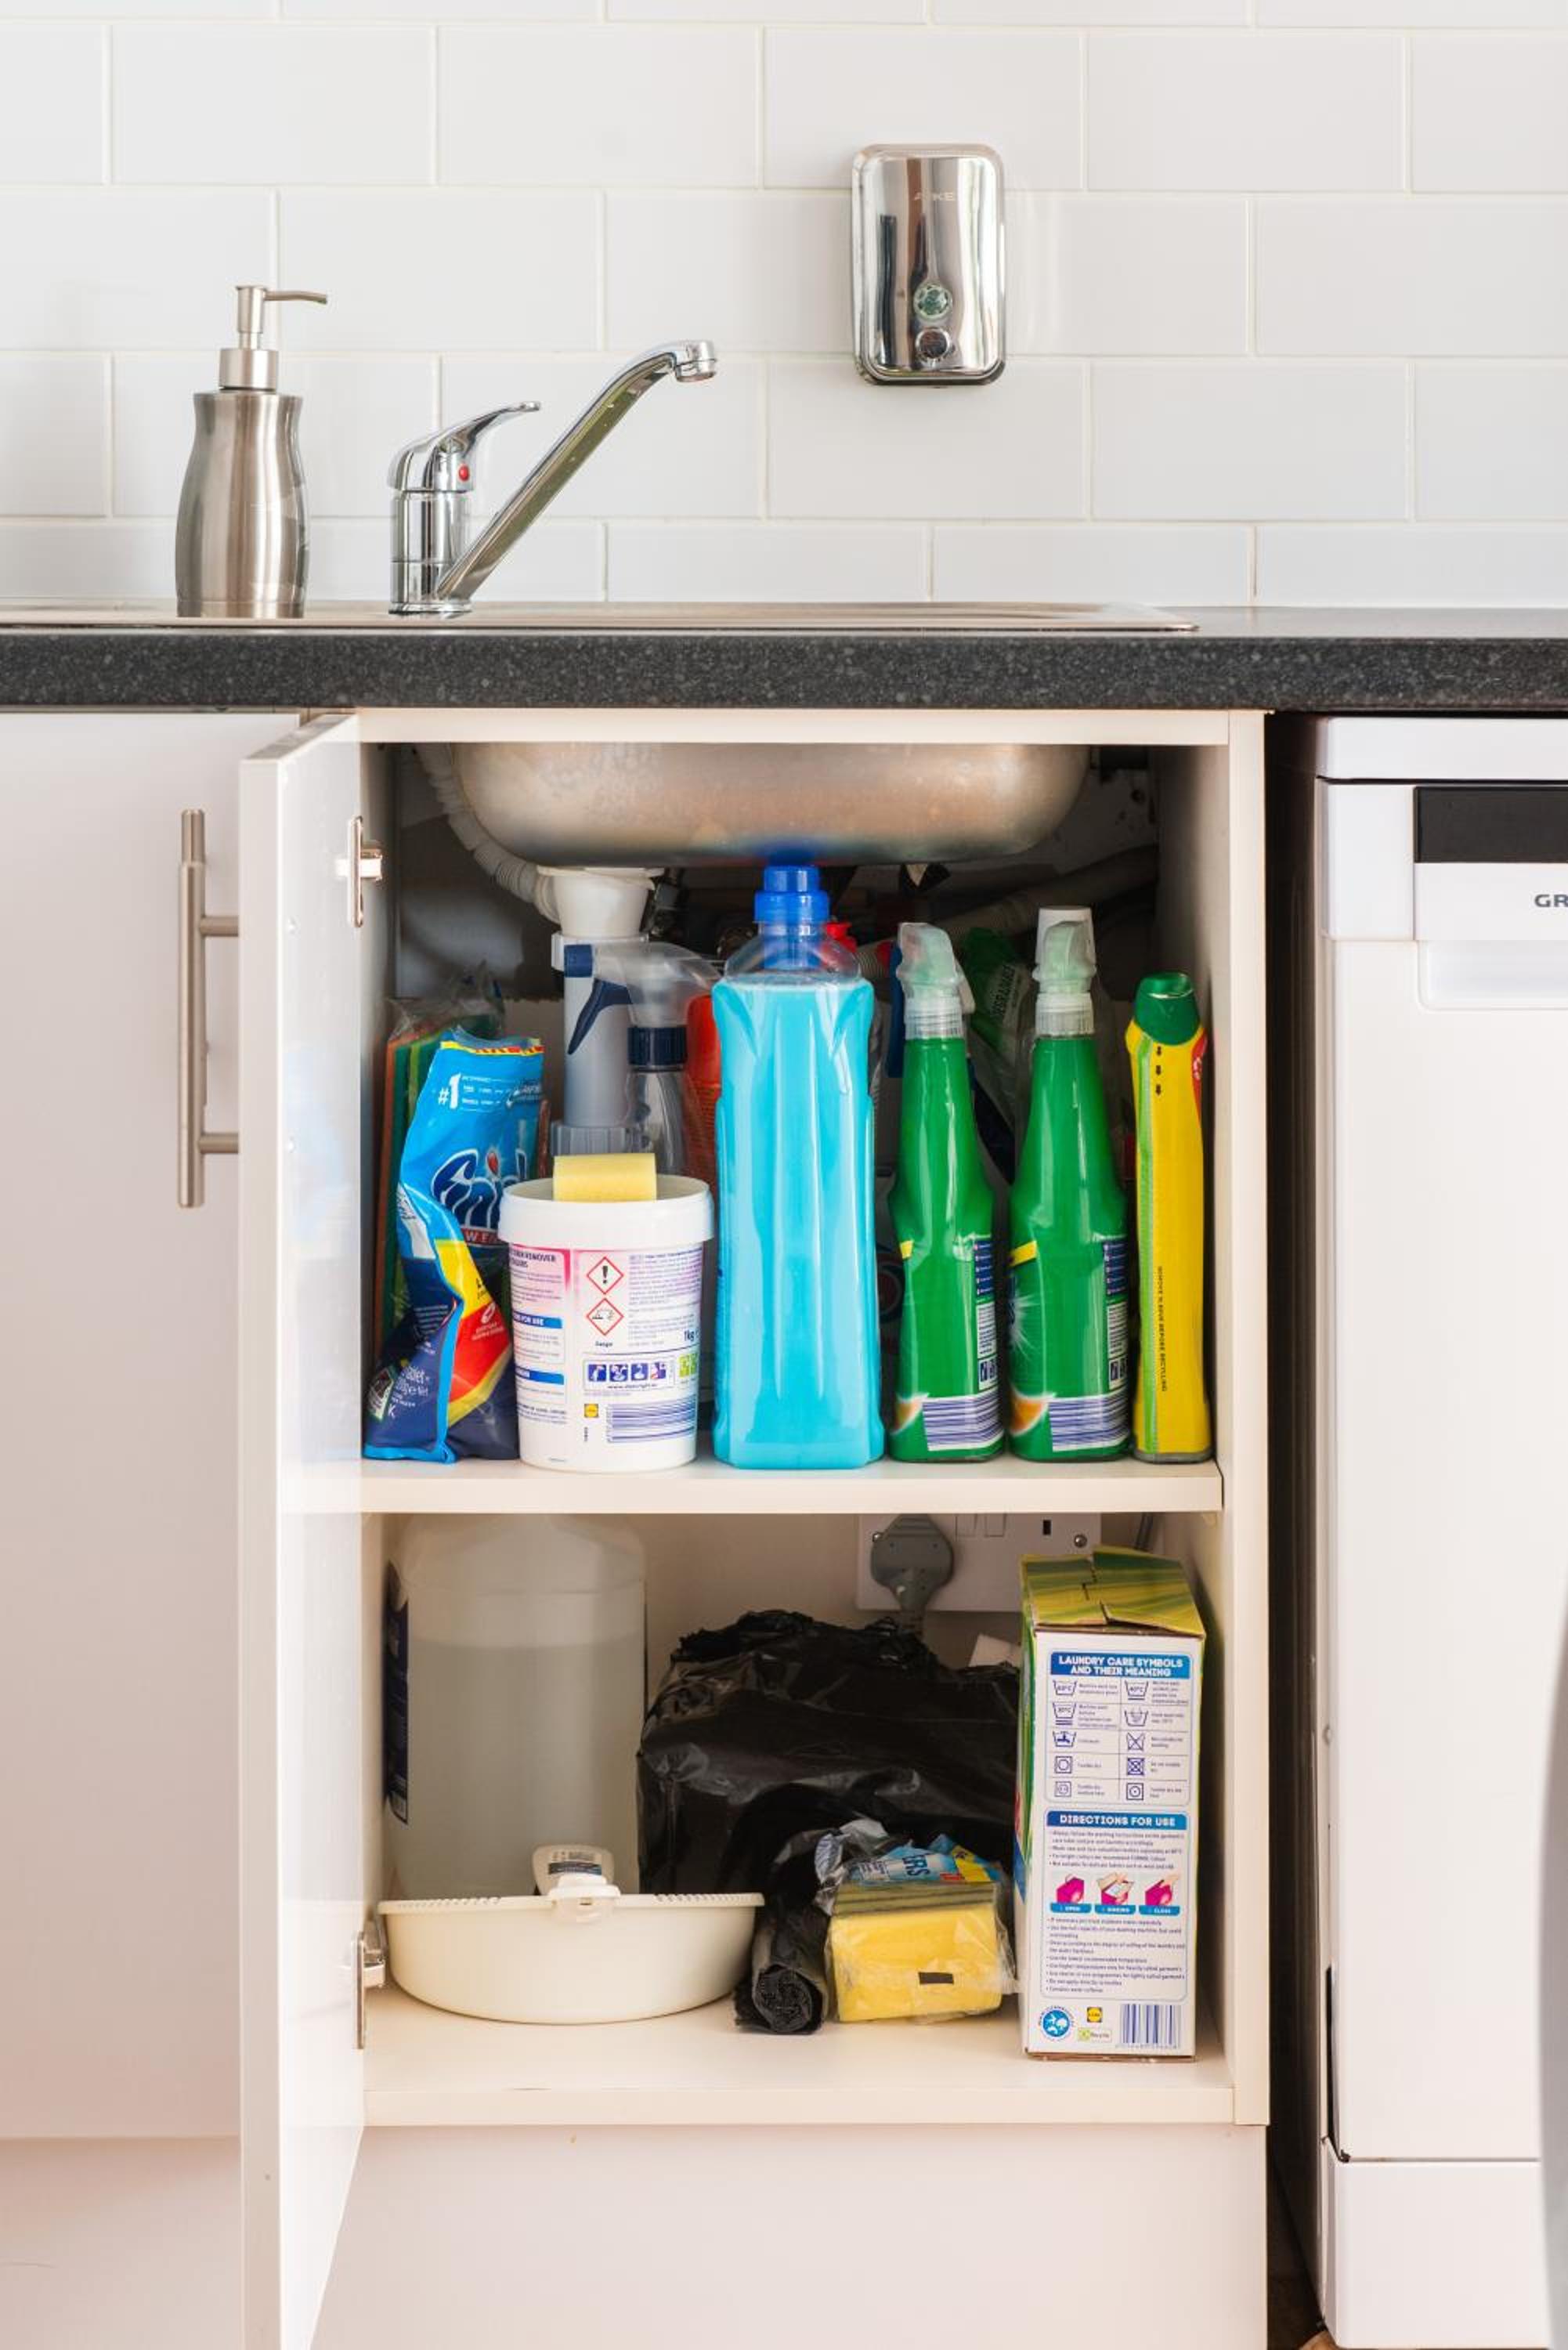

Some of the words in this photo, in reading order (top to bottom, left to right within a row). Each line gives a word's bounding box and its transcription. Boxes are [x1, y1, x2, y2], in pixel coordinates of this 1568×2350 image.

[1059, 1655, 1106, 1666] LAUNDRY
[1107, 1657, 1134, 1667] CARE
[1136, 1658, 1183, 1668] SYMBOLS
[1071, 1666, 1093, 1675] AND
[1093, 1667, 1123, 1676] THEIR
[1125, 1668, 1172, 1677] MEANING
[1060, 1814, 1129, 1825] DIRECTIONS
[1131, 1816, 1153, 1826] FOR
[1155, 1817, 1176, 1827] USE
